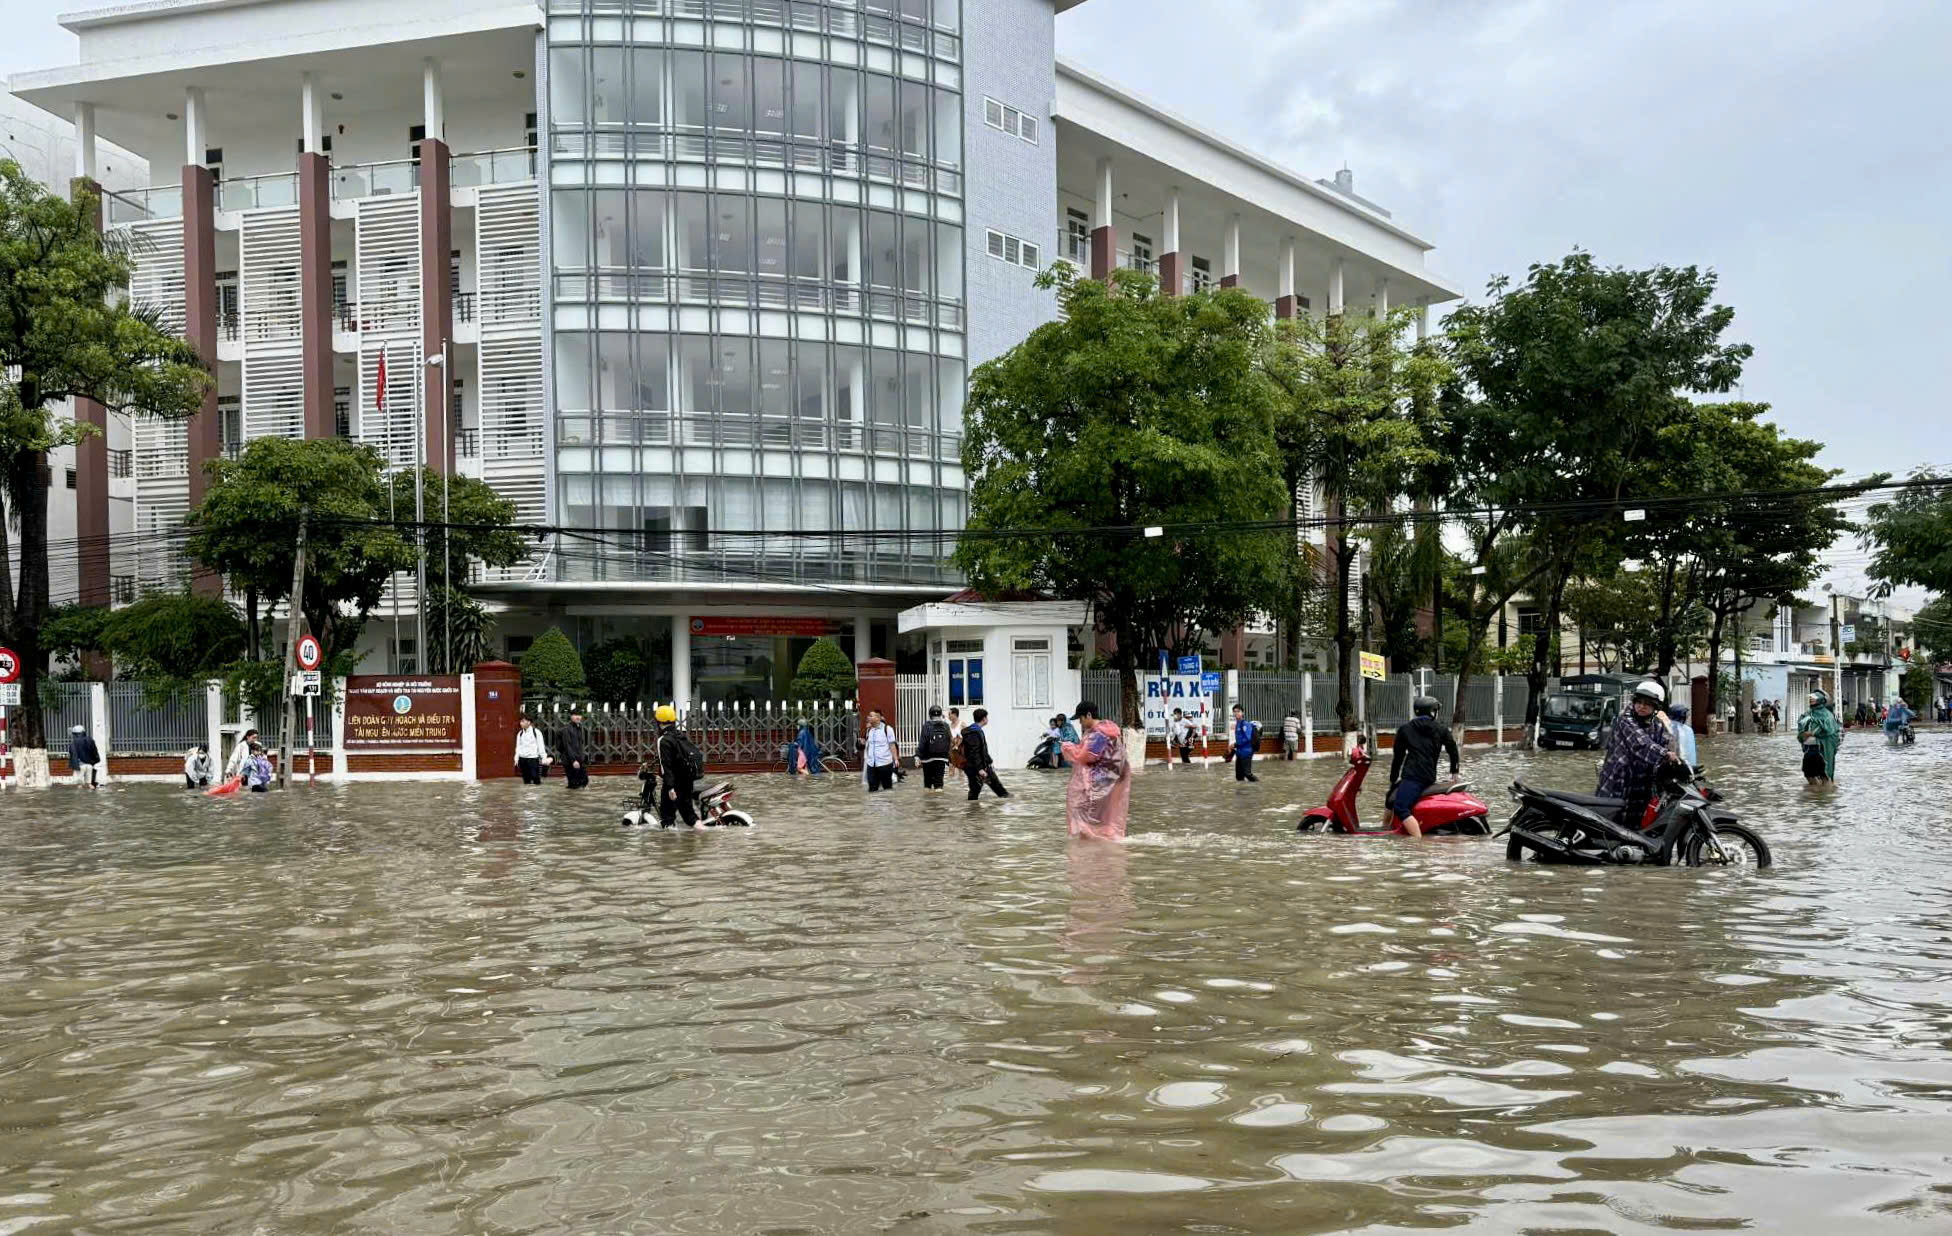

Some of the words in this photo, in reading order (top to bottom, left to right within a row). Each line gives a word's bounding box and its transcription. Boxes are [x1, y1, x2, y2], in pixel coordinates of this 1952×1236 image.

[304, 645, 313, 660] 40
[348, 714, 361, 724] LIÊN
[363, 714, 379, 724] ĐOÀN
[418, 713, 425, 724] VÀ
[354, 727, 364, 737] TÀI
[366, 727, 390, 737] NGUÊN
